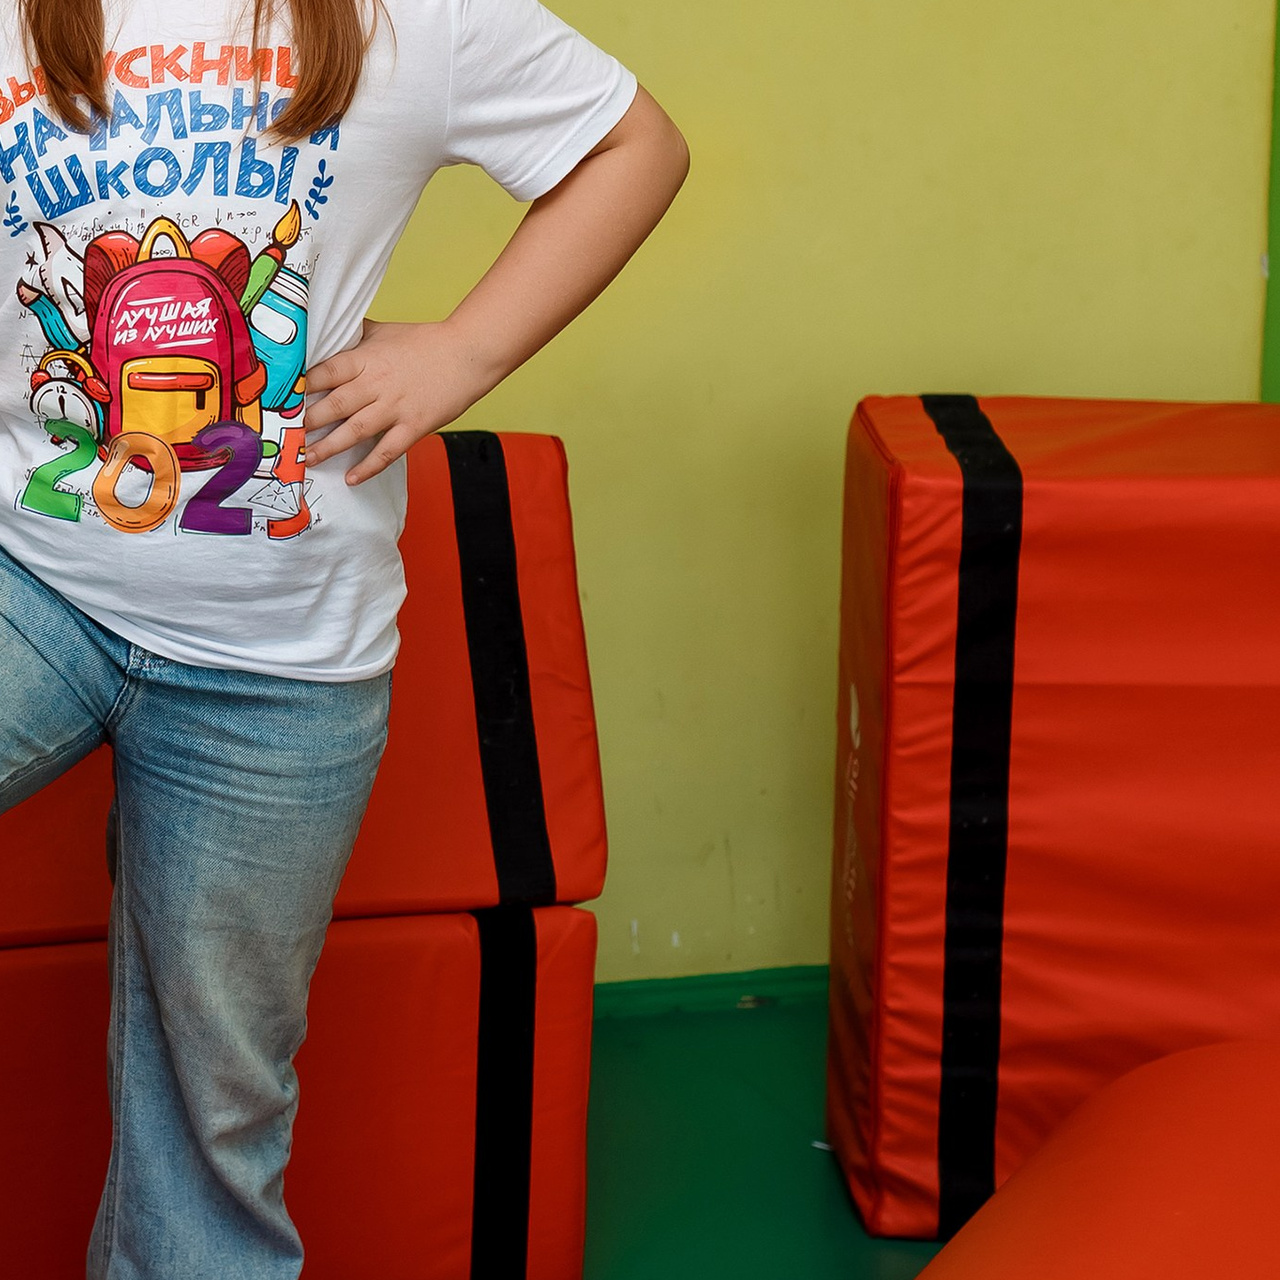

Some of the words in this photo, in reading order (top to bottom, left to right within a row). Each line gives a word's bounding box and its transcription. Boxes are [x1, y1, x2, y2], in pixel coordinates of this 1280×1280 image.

[115, 297, 212, 330] ЛУЧШАЯ
[113, 328, 138, 346] ИЗ
[142, 318, 219, 342] ЛУЧШИХ
[56, 385, 67, 394] 12
